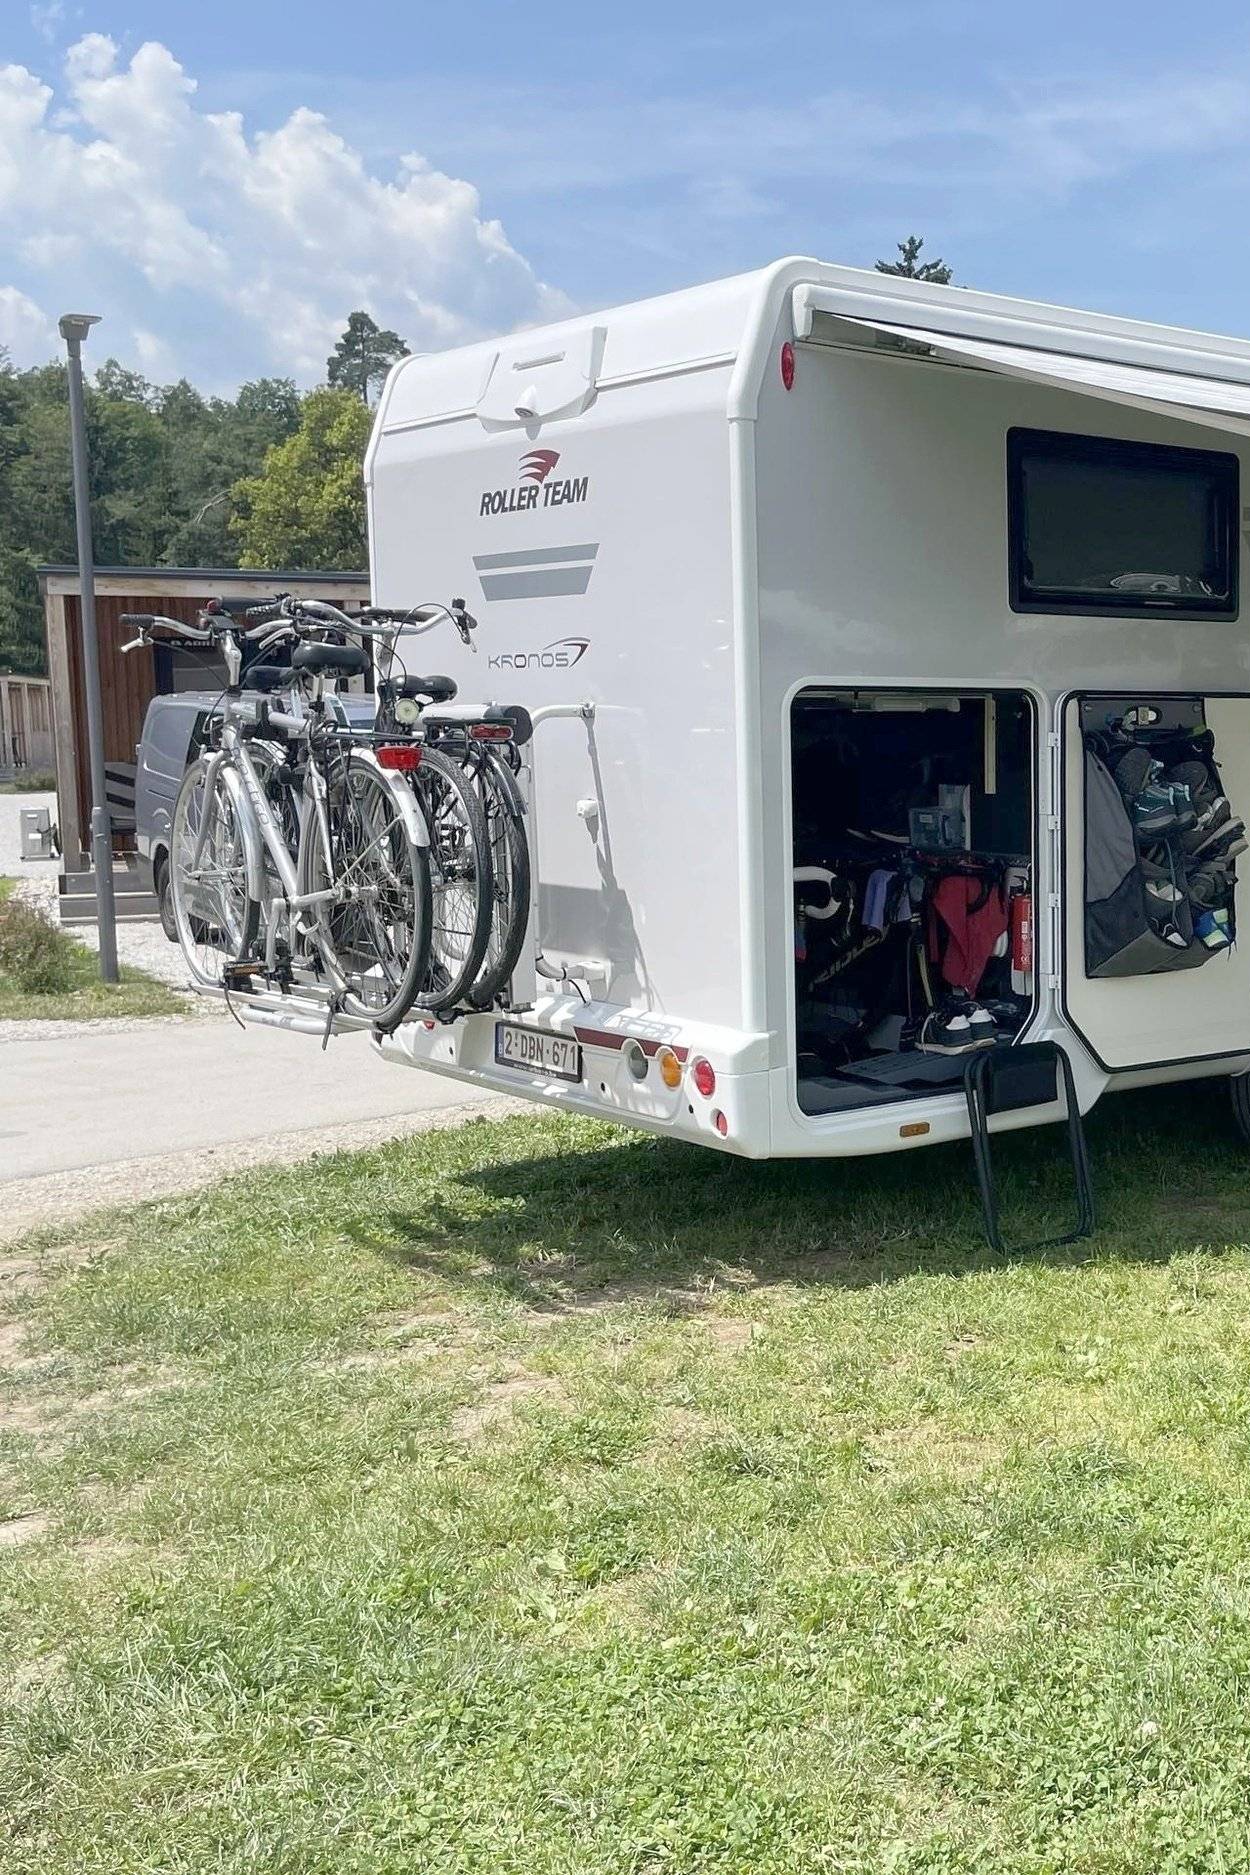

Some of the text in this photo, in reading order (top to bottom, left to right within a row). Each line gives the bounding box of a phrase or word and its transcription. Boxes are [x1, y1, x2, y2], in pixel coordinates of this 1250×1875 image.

[479, 476, 589, 516] ROLLER TEAM
[488, 652, 570, 669] KRONOS
